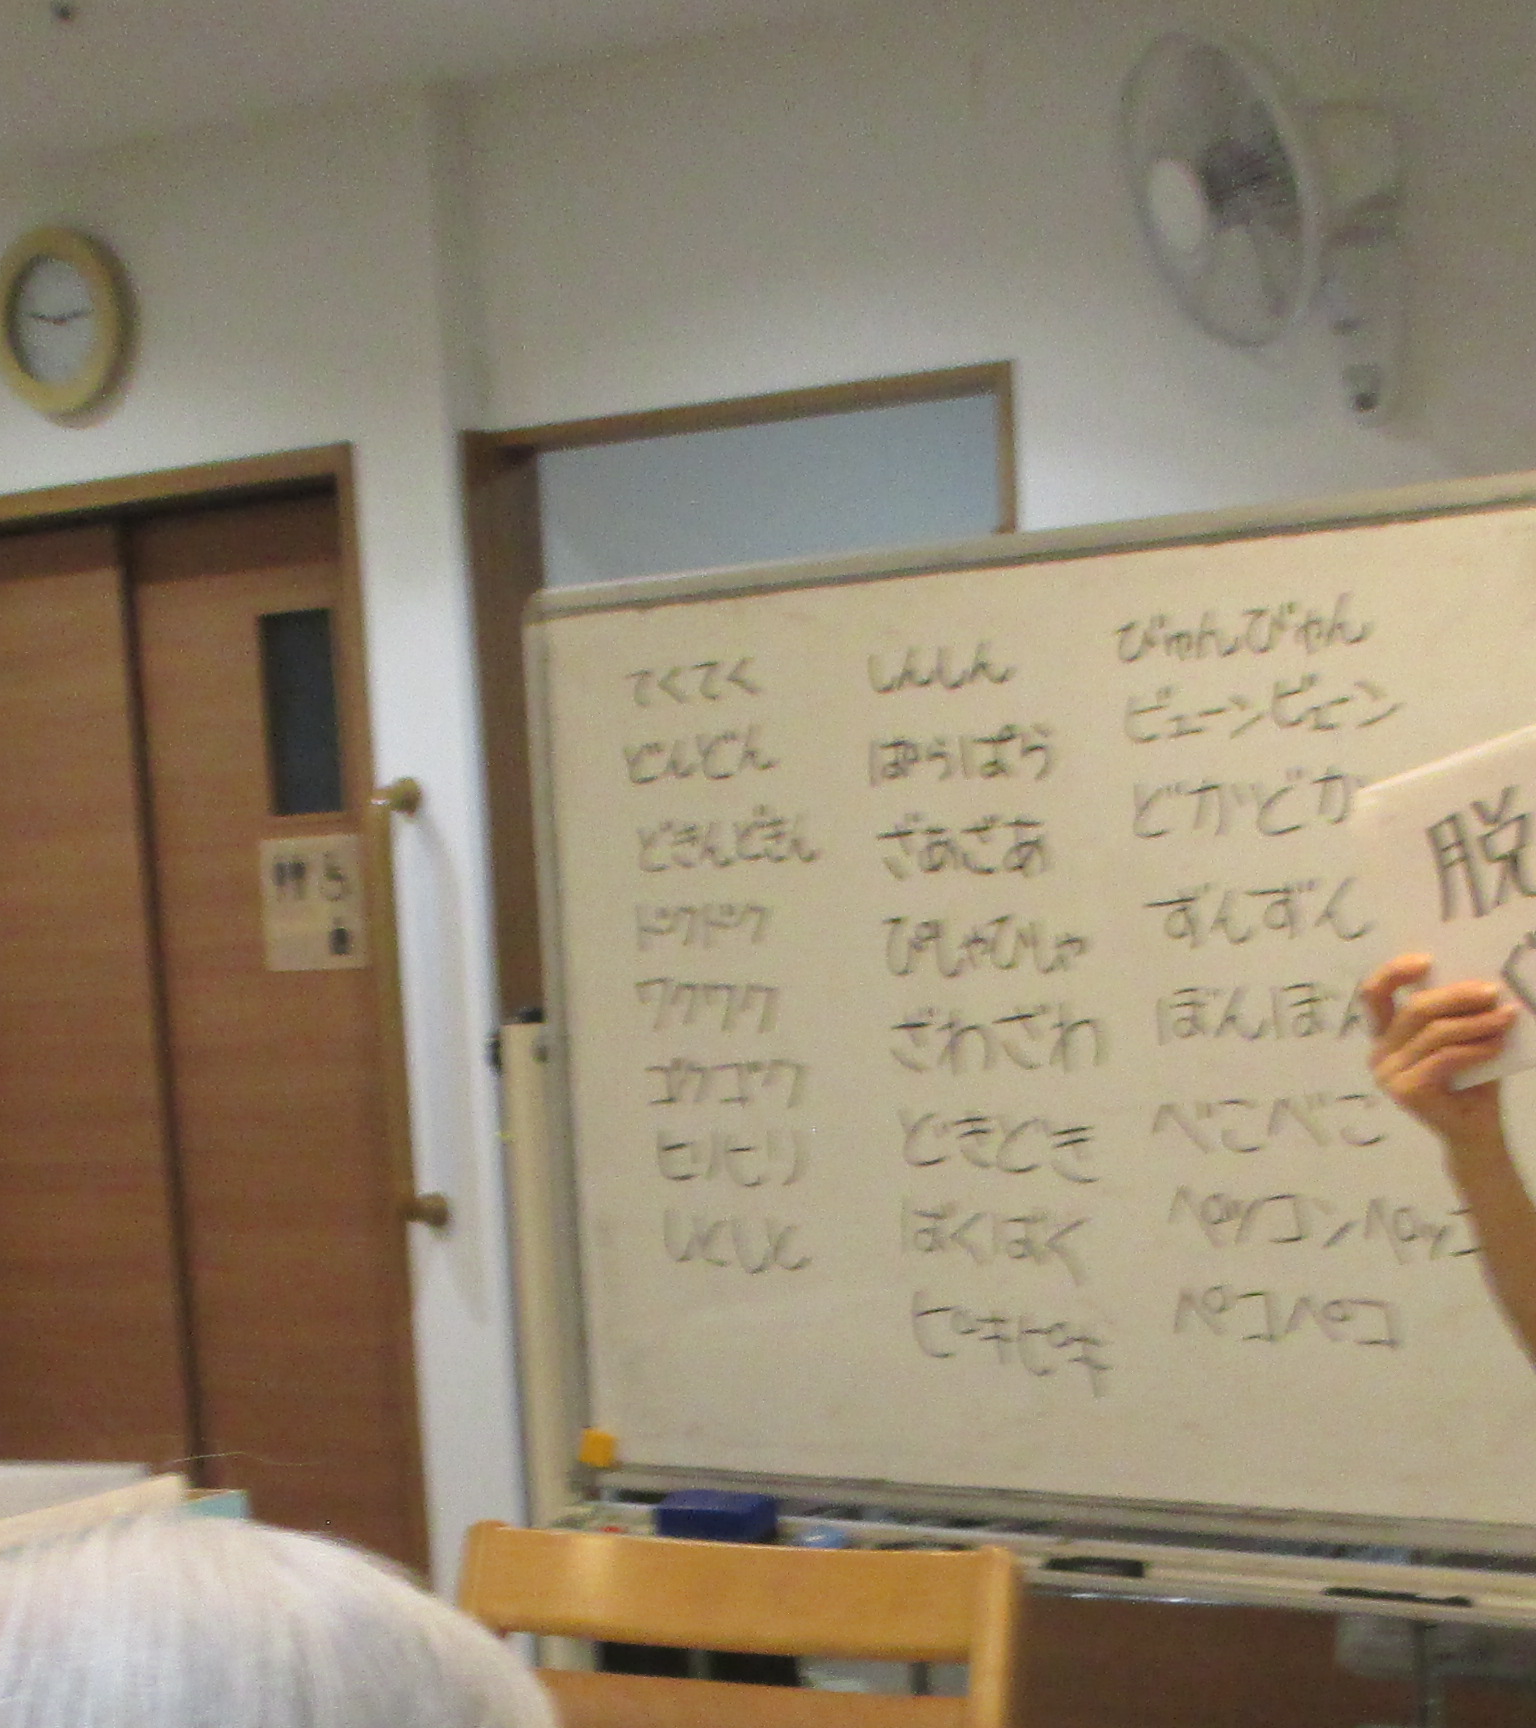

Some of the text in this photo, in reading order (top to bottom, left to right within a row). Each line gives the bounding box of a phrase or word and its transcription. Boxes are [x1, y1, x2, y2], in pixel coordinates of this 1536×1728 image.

[625, 656, 765, 708] てくてく
[889, 1002, 1109, 1076] ざわざわ
[1174, 1285, 1402, 1350] ペコペコ
